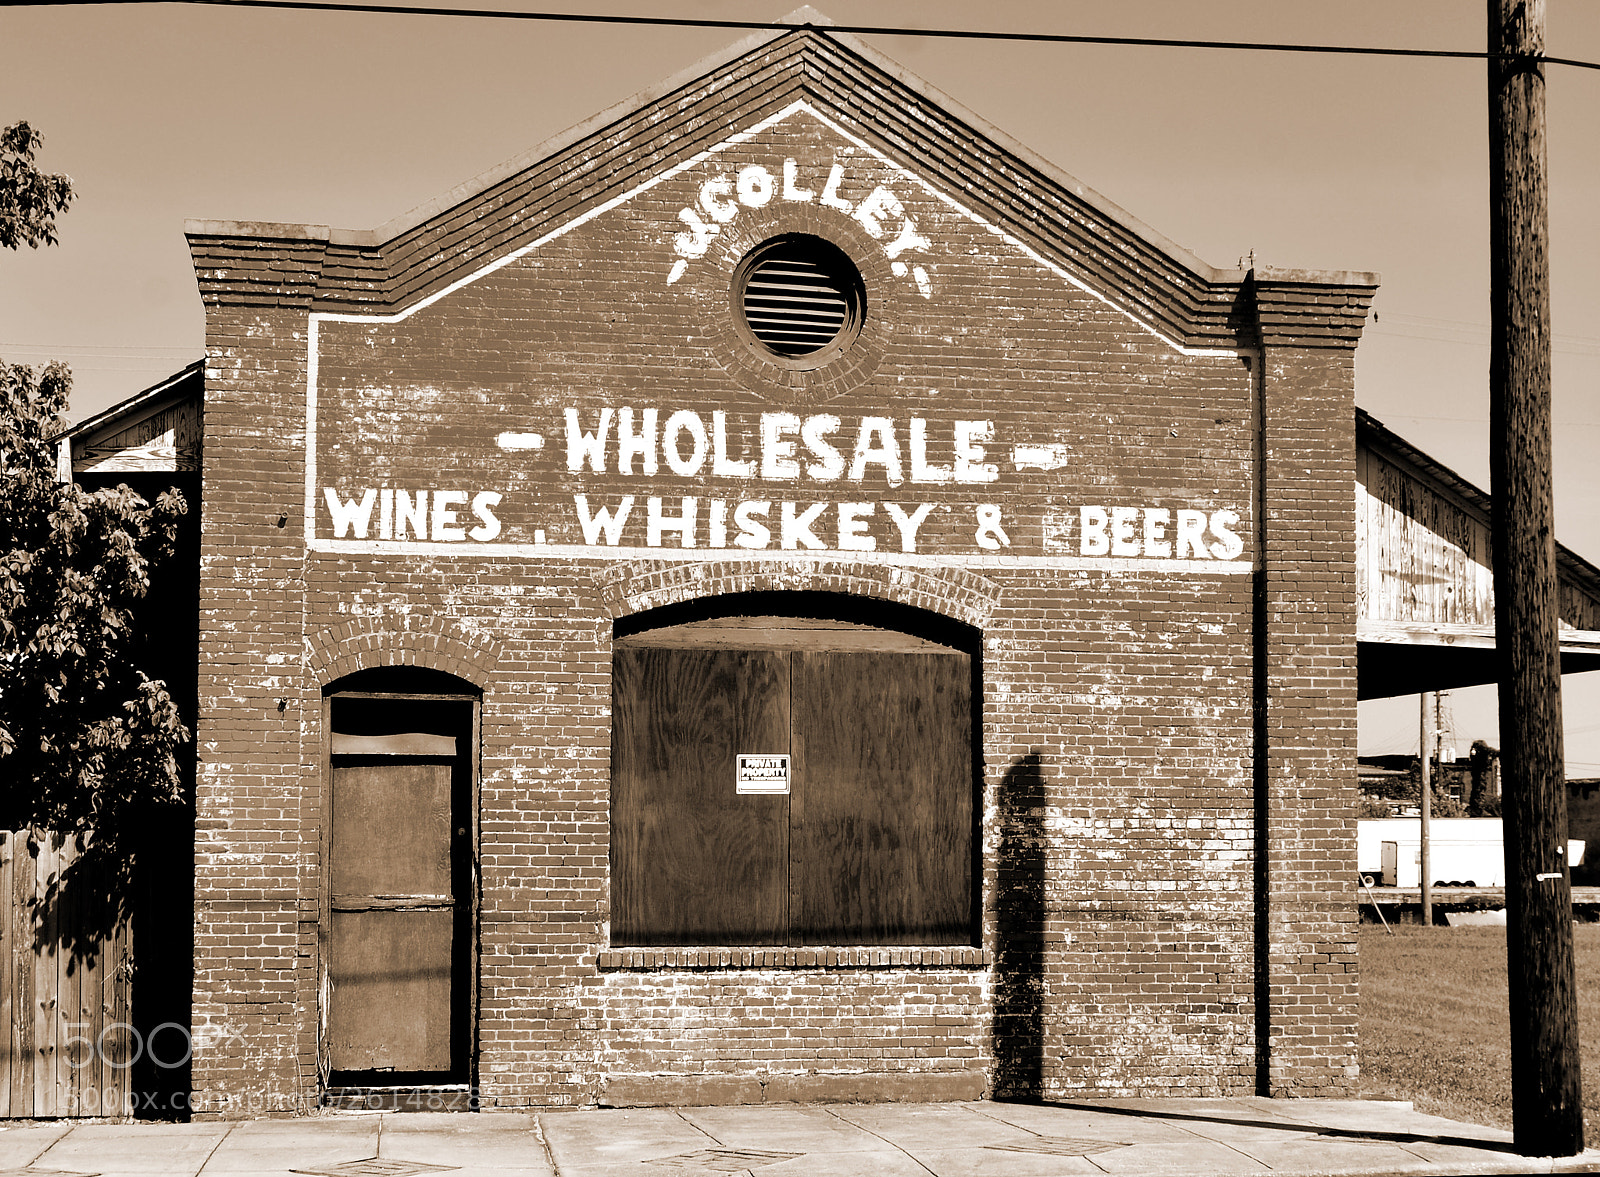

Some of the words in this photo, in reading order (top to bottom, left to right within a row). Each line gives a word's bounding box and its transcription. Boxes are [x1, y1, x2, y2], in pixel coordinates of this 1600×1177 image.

[564, 406, 999, 487] WHOLESALE
[574, 493, 938, 553] WHISKEY
[975, 503, 1011, 550] &
[1079, 505, 1244, 560] BEERS
[741, 767, 787, 777] PROPERTY
[745, 758, 782, 768] PRIVATE
